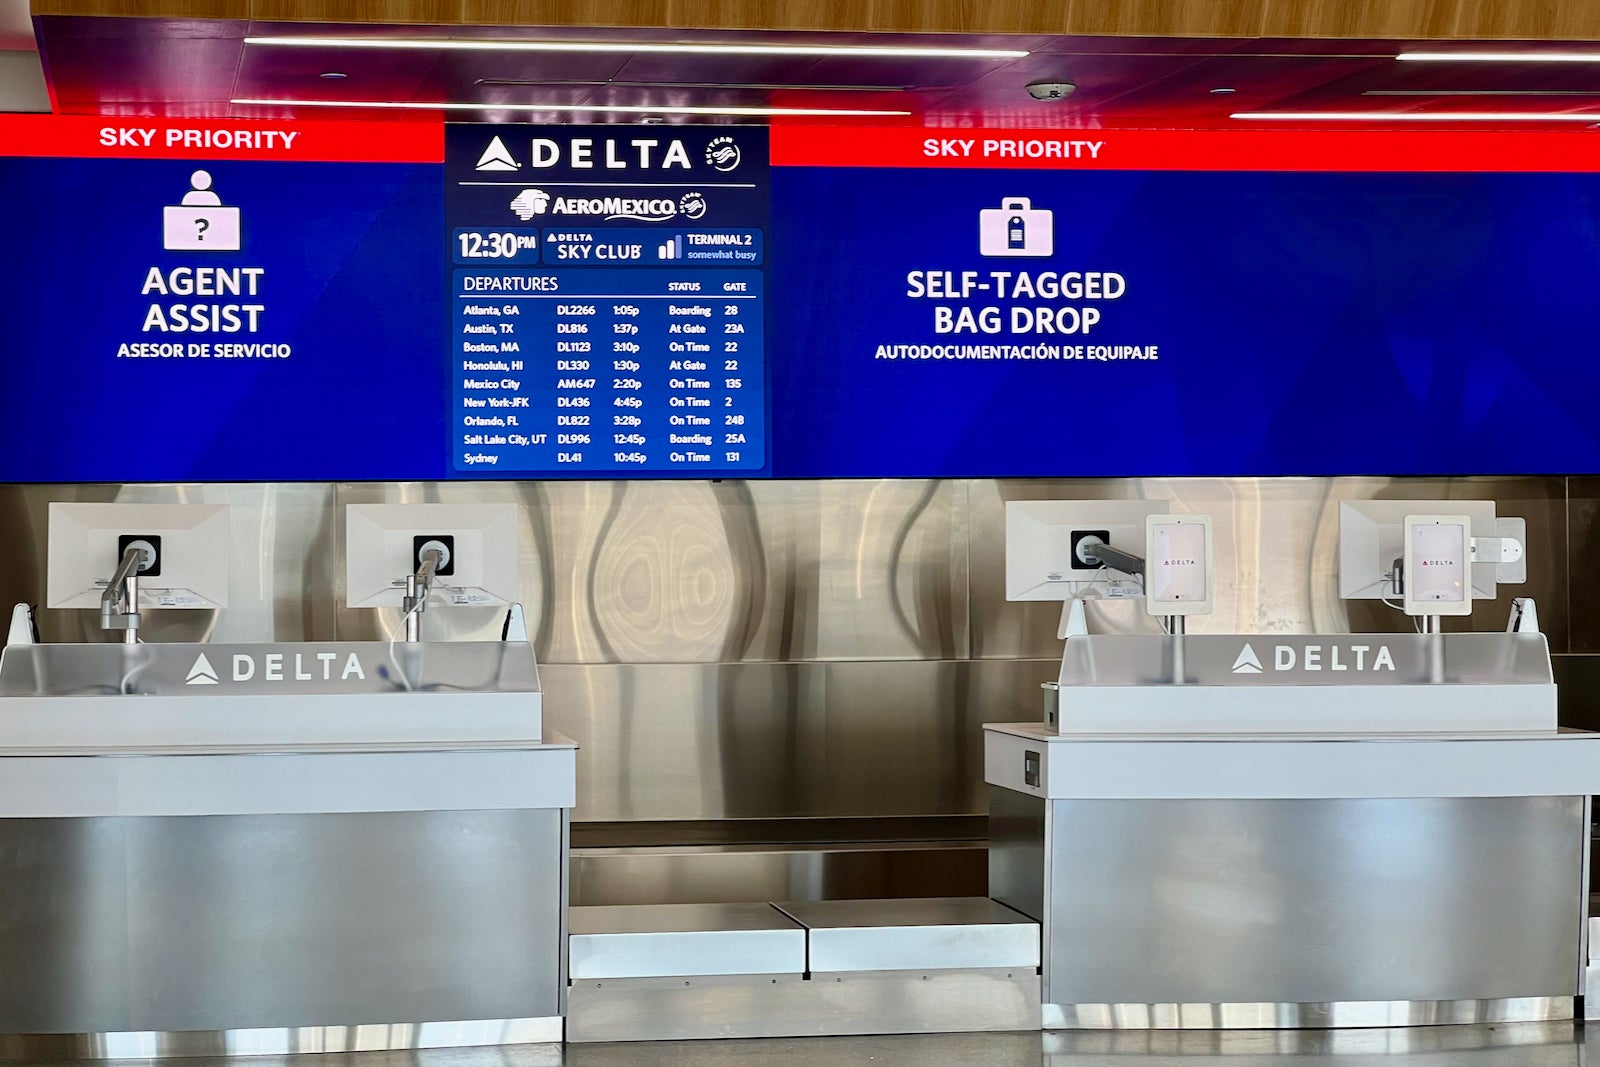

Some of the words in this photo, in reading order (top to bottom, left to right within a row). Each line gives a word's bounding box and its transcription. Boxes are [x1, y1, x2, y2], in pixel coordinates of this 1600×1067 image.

[100, 128, 156, 146] SKY
[166, 129, 297, 149] PRIORITY
[533, 139, 691, 168] DELTA
[924, 139, 975, 156] SKY
[984, 140, 1102, 158] PRIORITY
[687, 234, 743, 245] TERMINAL
[744, 235, 752, 245] 2
[558, 244, 591, 259] SKY
[596, 245, 642, 259] CLUB
[688, 250, 733, 259] somewhat
[735, 250, 756, 261] busy
[141, 267, 264, 295] AGENT
[464, 277, 558, 291] DEPARTURES
[669, 282, 700, 291] STATUS
[723, 283, 746, 291] GATE
[907, 271, 1125, 299] SELF-TAGGED
[142, 304, 264, 332] ASSIST
[463, 305, 501, 316] Atlanta,
[503, 305, 519, 315] GA
[557, 305, 596, 315] DL2266
[613, 305, 639, 316] 1:05p
[669, 305, 711, 317] Boarding
[725, 306, 738, 315] 28
[935, 307, 1001, 333] BAG
[1012, 307, 1100, 334] DROP
[464, 324, 497, 335] Austin,
[499, 324, 513, 333] TX
[557, 324, 588, 333] DL816
[613, 324, 638, 335] 1:37p
[669, 324, 681, 333] At
[683, 324, 706, 333] Gate
[725, 324, 744, 333] 23A
[117, 343, 184, 357] ASESOR
[188, 344, 210, 357] DE
[214, 344, 291, 358] SERVICIO
[464, 342, 499, 353] Boston,
[501, 342, 519, 351] MA
[557, 342, 591, 352] DL1123
[613, 342, 640, 353] 3:10p
[669, 342, 684, 351] On
[685, 342, 710, 351] Time
[725, 342, 737, 352] 22
[875, 343, 1059, 359] AUTODOCUMENTACIÓN
[1063, 346, 1083, 359] DE
[1087, 346, 1158, 361] EQUIPAJE
[464, 361, 510, 371] Honolulu,
[512, 361, 523, 370] HI
[557, 360, 589, 370] DL330
[614, 360, 640, 372] 1:30p
[669, 360, 681, 370] At
[683, 360, 706, 370] Gate
[725, 360, 737, 370] 22
[464, 379, 499, 389] Mexico
[501, 379, 520, 390] City
[557, 379, 595, 388] AM647
[614, 379, 642, 390] 2:20p
[669, 379, 684, 388] On
[686, 379, 710, 388] Time
[725, 379, 741, 388] 135
[464, 398, 484, 407] New
[488, 397, 529, 407] York-JFK
[558, 397, 590, 407] DL436
[614, 397, 642, 408] 4:45p
[670, 397, 684, 406] On
[686, 397, 710, 406] Time
[725, 397, 732, 406] 2
[464, 416, 505, 427] Orlando,
[507, 416, 519, 425] FL
[558, 416, 589, 425] DL822
[614, 416, 641, 427] 3:28p
[670, 416, 684, 425] On
[686, 415, 710, 425] Time
[725, 415, 744, 425] 24B
[464, 435, 483, 444] Salt
[484, 435, 506, 444] Lake
[508, 434, 529, 446] City,
[532, 434, 547, 444] UT
[558, 434, 590, 444] DL996
[614, 434, 646, 445] 12:45p
[670, 434, 712, 445] Boarding
[725, 434, 746, 443] 25A
[464, 453, 498, 464] Sydney
[558, 453, 581, 462] DL41
[614, 453, 646, 463] 10:45p
[670, 452, 685, 462] On
[686, 452, 710, 461] Time
[726, 452, 739, 461] 131
[1275, 645, 1396, 671] DELTA
[233, 653, 366, 681] DELTA
